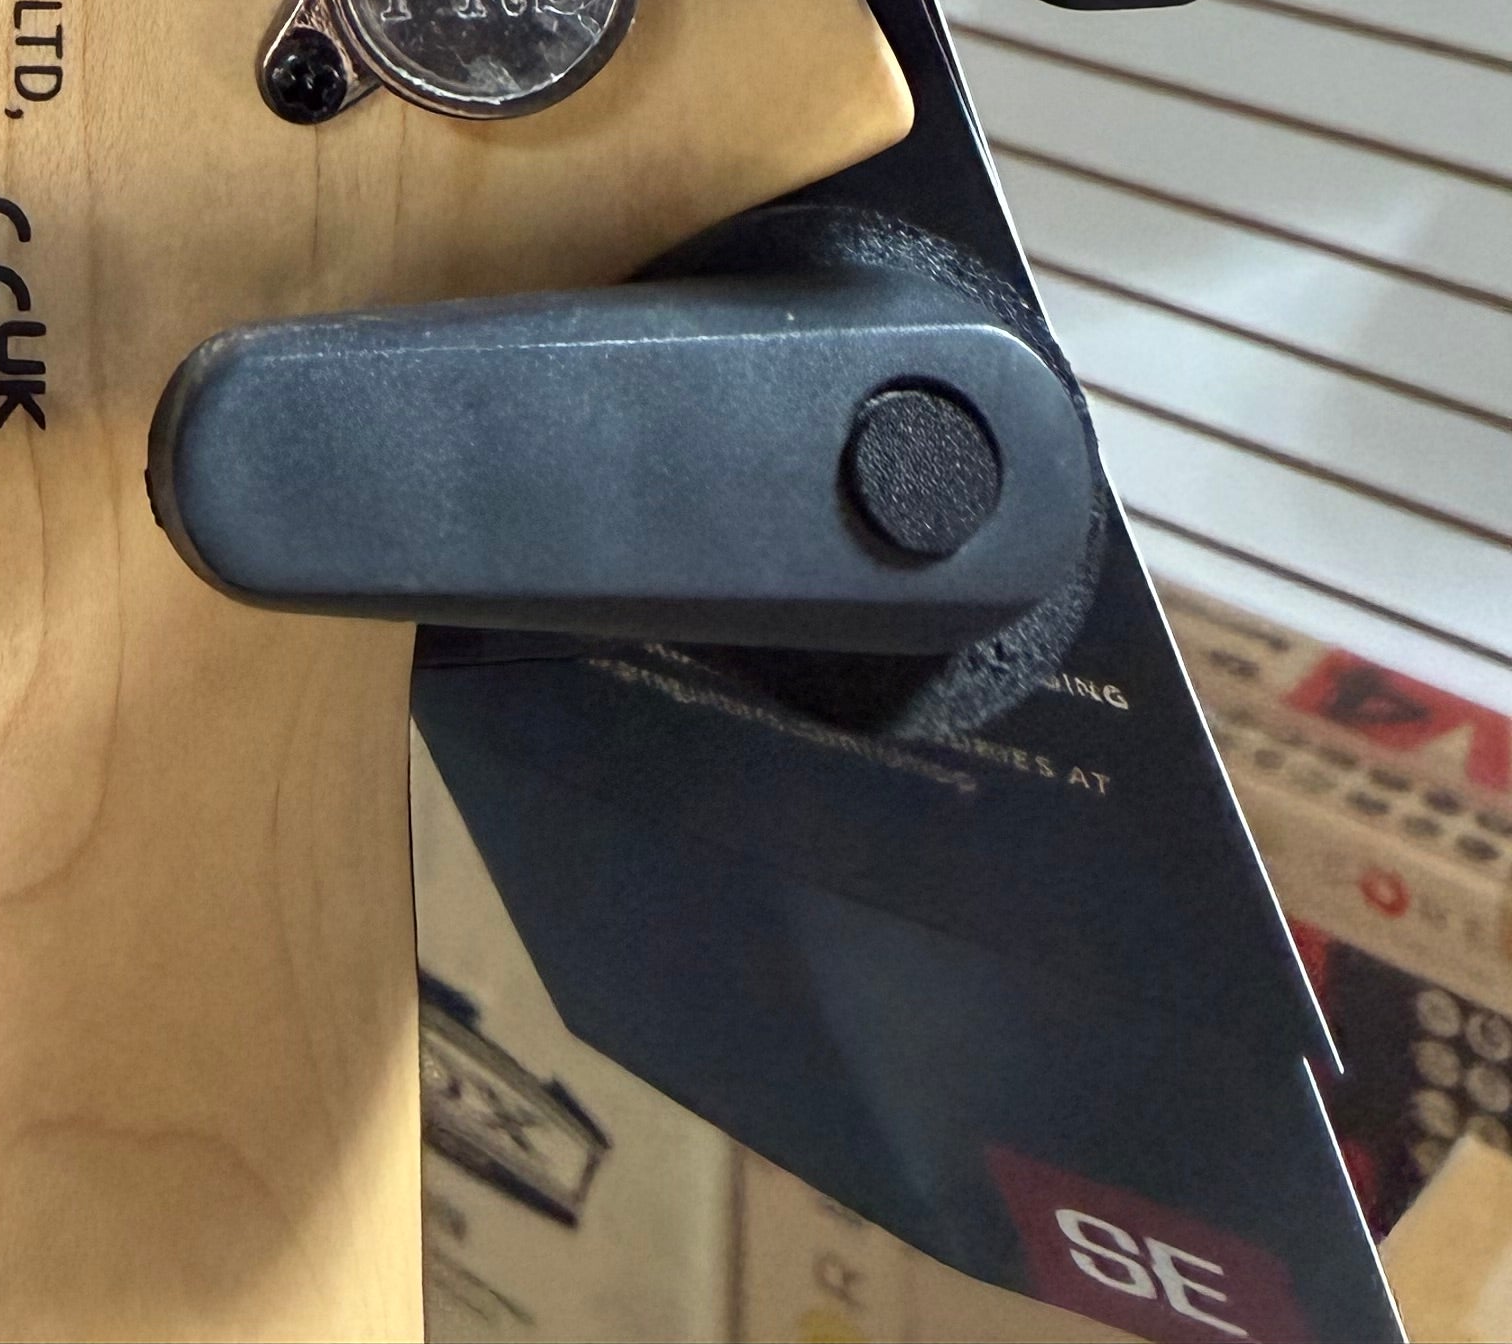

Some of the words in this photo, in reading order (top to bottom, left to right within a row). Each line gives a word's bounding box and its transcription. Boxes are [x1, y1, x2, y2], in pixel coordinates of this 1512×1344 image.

[4, 0, 64, 119] LTD,
[1068, 766, 1111, 796] AT
[1055, 1208, 1249, 1336] SE
